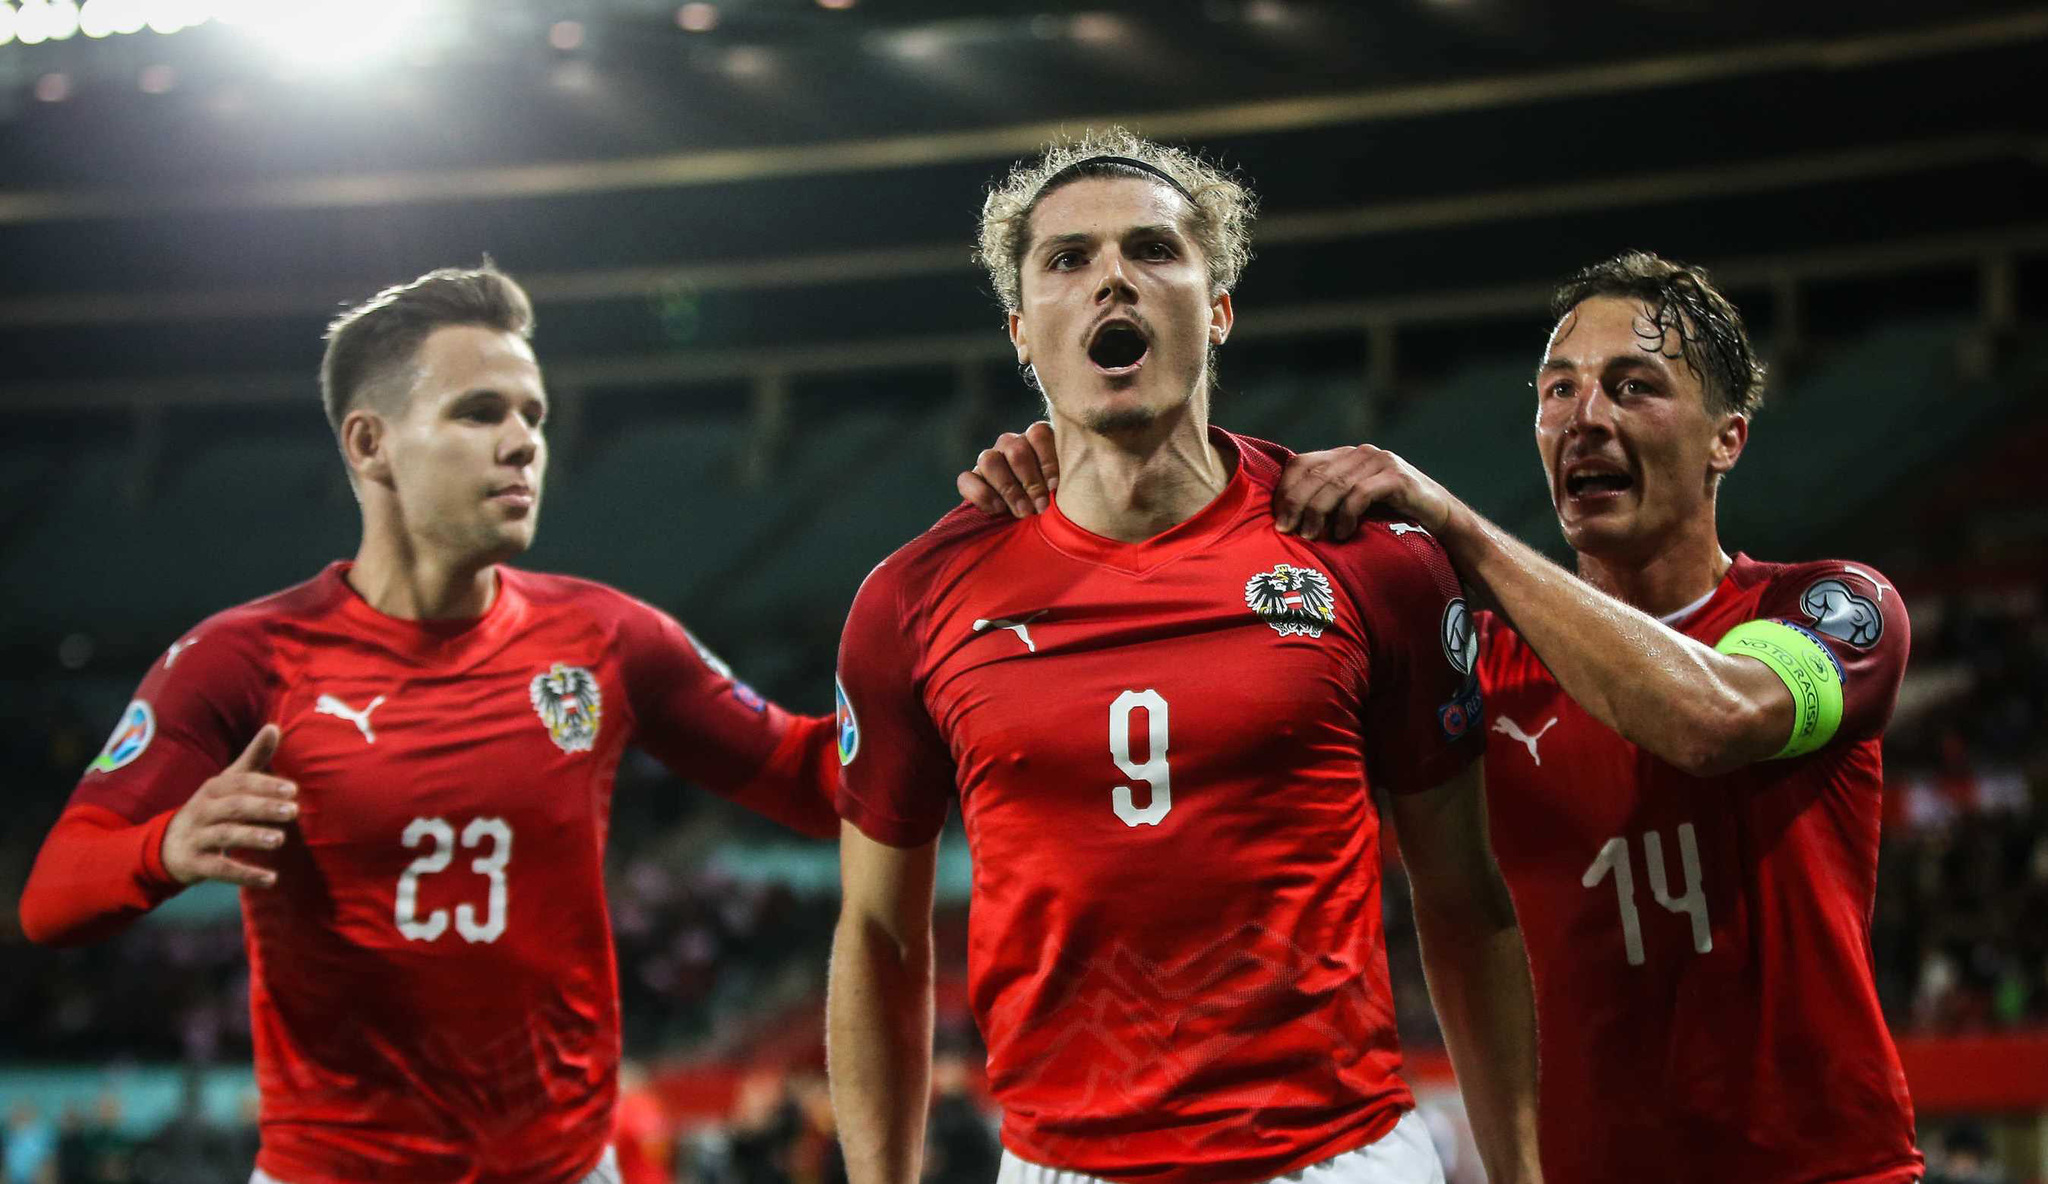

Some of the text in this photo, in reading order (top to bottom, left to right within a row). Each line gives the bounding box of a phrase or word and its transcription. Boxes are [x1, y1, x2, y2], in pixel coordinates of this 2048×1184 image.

[1738, 638, 1768, 649] NO
[1771, 647, 1793, 666] TO
[1793, 668, 1816, 738] RACISM
[1109, 688, 1172, 828] 9
[395, 817, 514, 944] 23
[1581, 822, 1714, 966] 14
